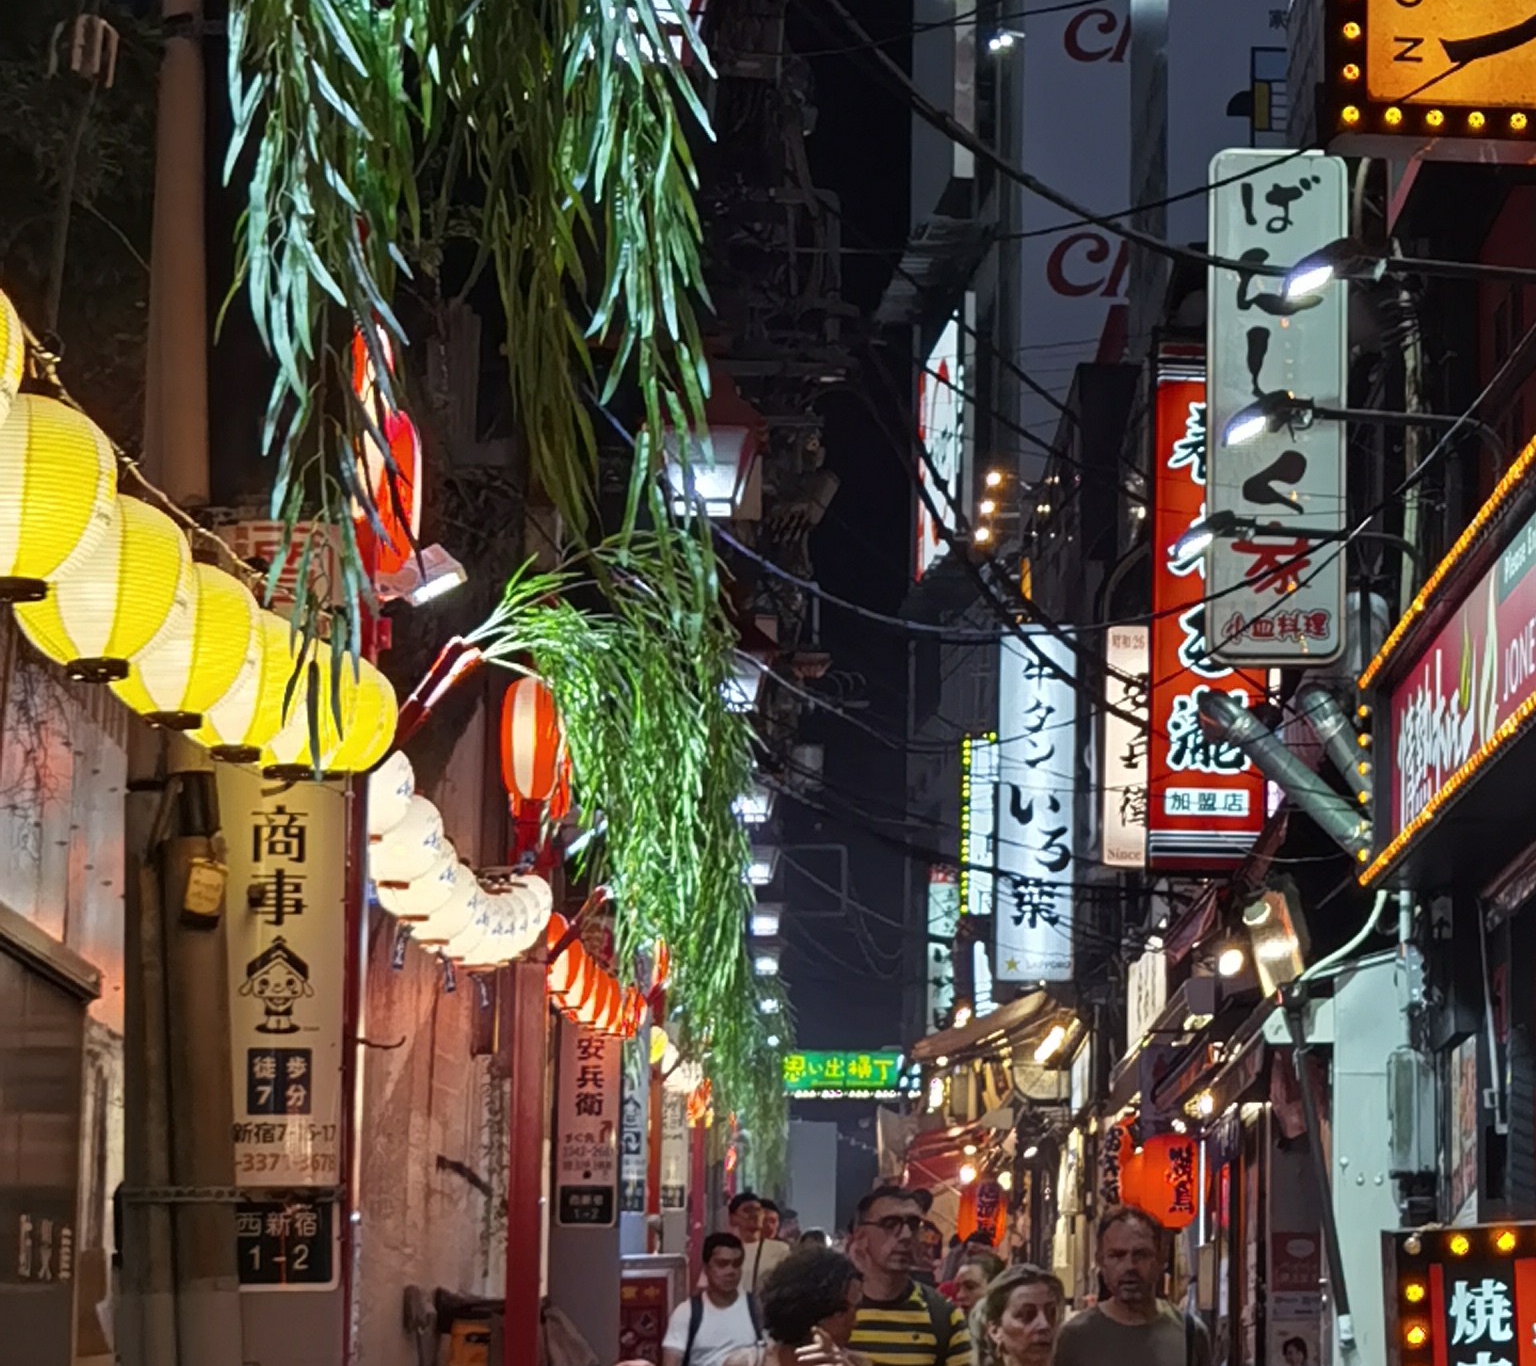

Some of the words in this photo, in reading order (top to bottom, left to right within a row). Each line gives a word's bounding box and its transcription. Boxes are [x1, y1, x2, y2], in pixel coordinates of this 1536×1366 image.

[1169, 792, 1244, 812] 加盟店
[1008, 781, 1071, 929] いろ葉
[1106, 846, 1142, 861] Since
[252, 1055, 308, 1080] 徒歩
[784, 1054, 895, 1084] 思い出横丁
[254, 1085, 307, 1107] 7分
[247, 1243, 311, 1271] 1-2
